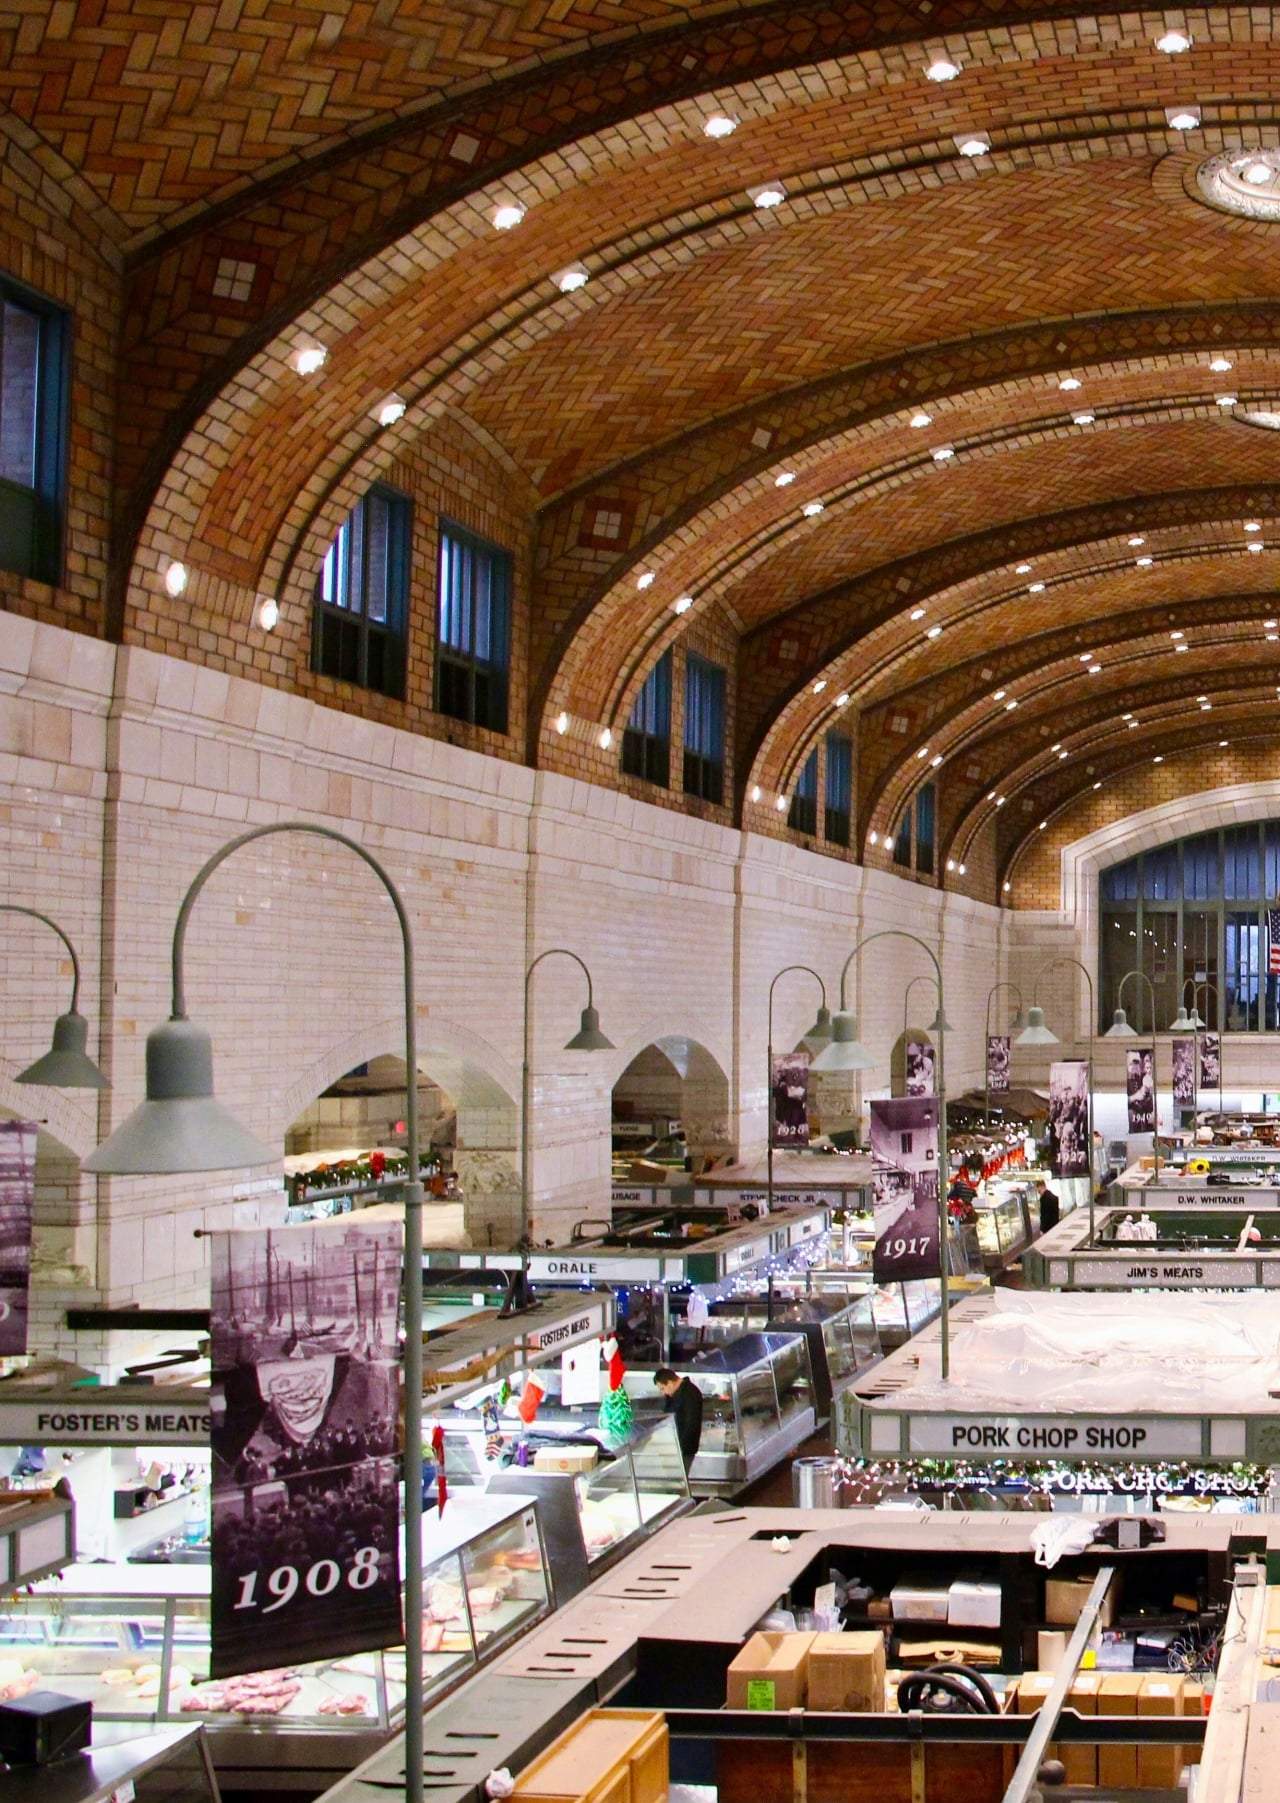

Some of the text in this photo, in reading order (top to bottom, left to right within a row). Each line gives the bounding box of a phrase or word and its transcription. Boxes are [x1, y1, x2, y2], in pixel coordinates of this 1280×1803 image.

[1056, 1150, 1084, 1164] 1927
[612, 1192, 641, 1200] USAGE
[1178, 1195, 1245, 1205] D.W. WHITAKER
[883, 1236, 931, 1259] 1917
[548, 1262, 598, 1274] ORALE
[1127, 1267, 1204, 1279] JIM'S MEATS
[540, 1316, 590, 1347] FOSTER'S MEATS
[38, 1413, 212, 1431] FOSTER'S MEATS
[952, 1426, 1146, 1448] PORK CHOP SHOP
[1042, 1470, 1114, 1491] PORK
[1194, 1470, 1264, 1491] SHOP
[233, 1546, 380, 1614] 1908
